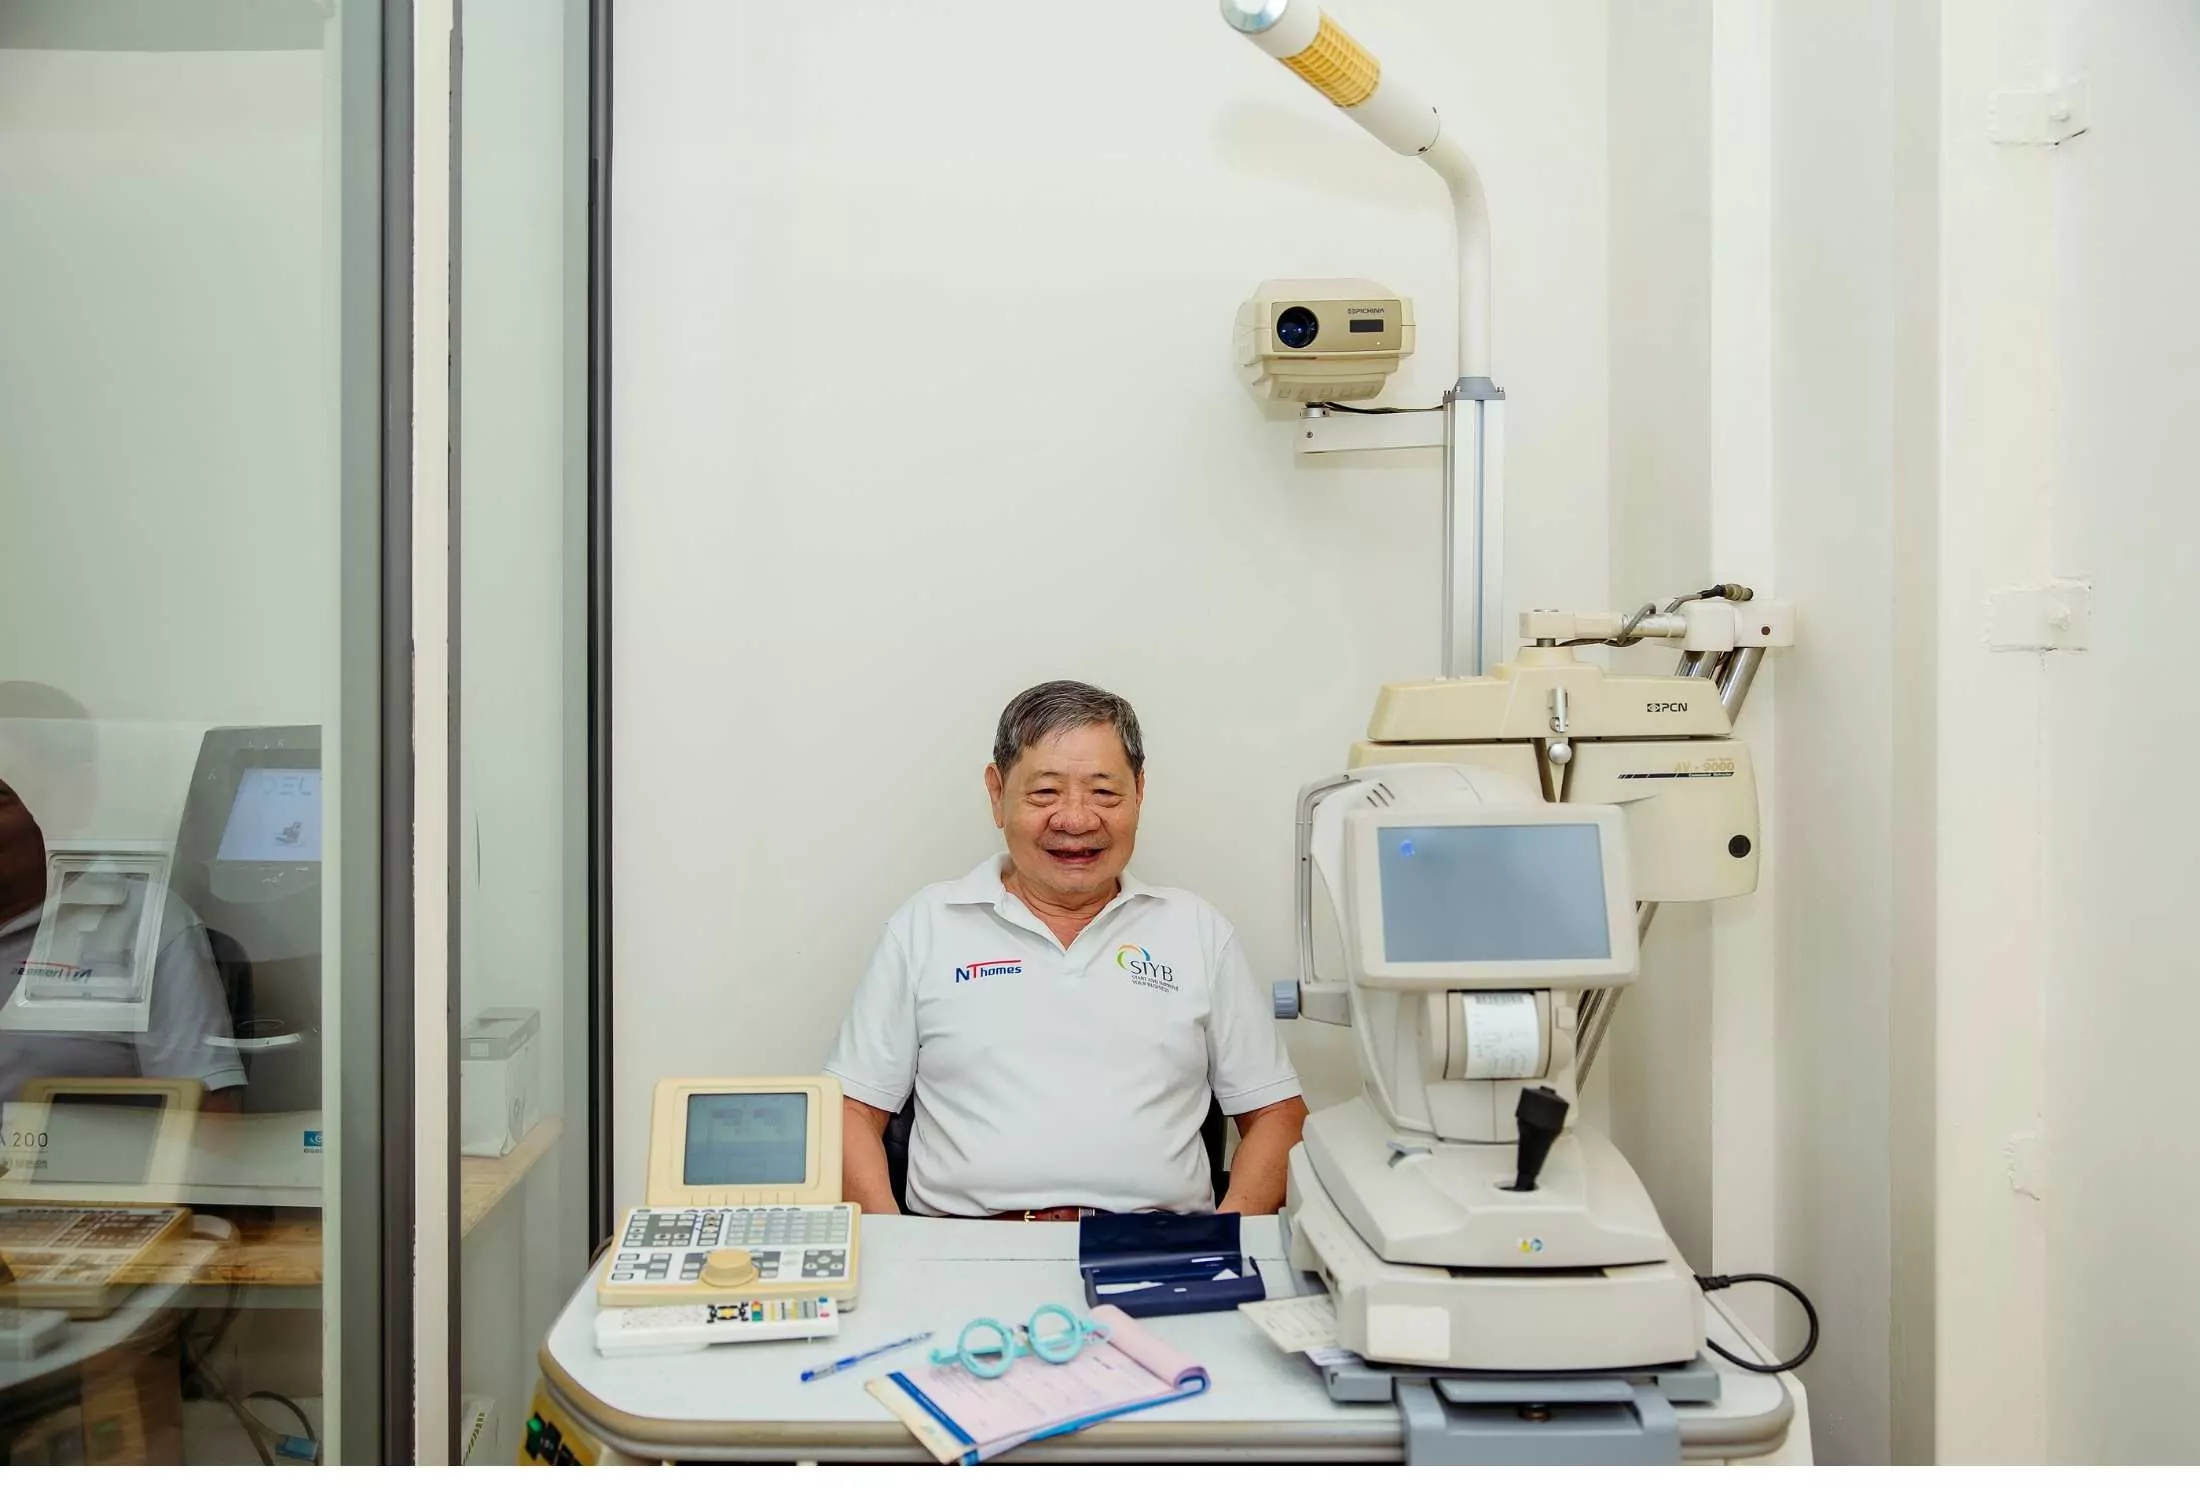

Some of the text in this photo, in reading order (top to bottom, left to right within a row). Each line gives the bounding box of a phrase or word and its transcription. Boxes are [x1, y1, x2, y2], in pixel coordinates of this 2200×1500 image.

[1661, 702, 1688, 713] PCN
[1130, 960, 1173, 982] SIYB
[12, 1132, 48, 1148] 200
